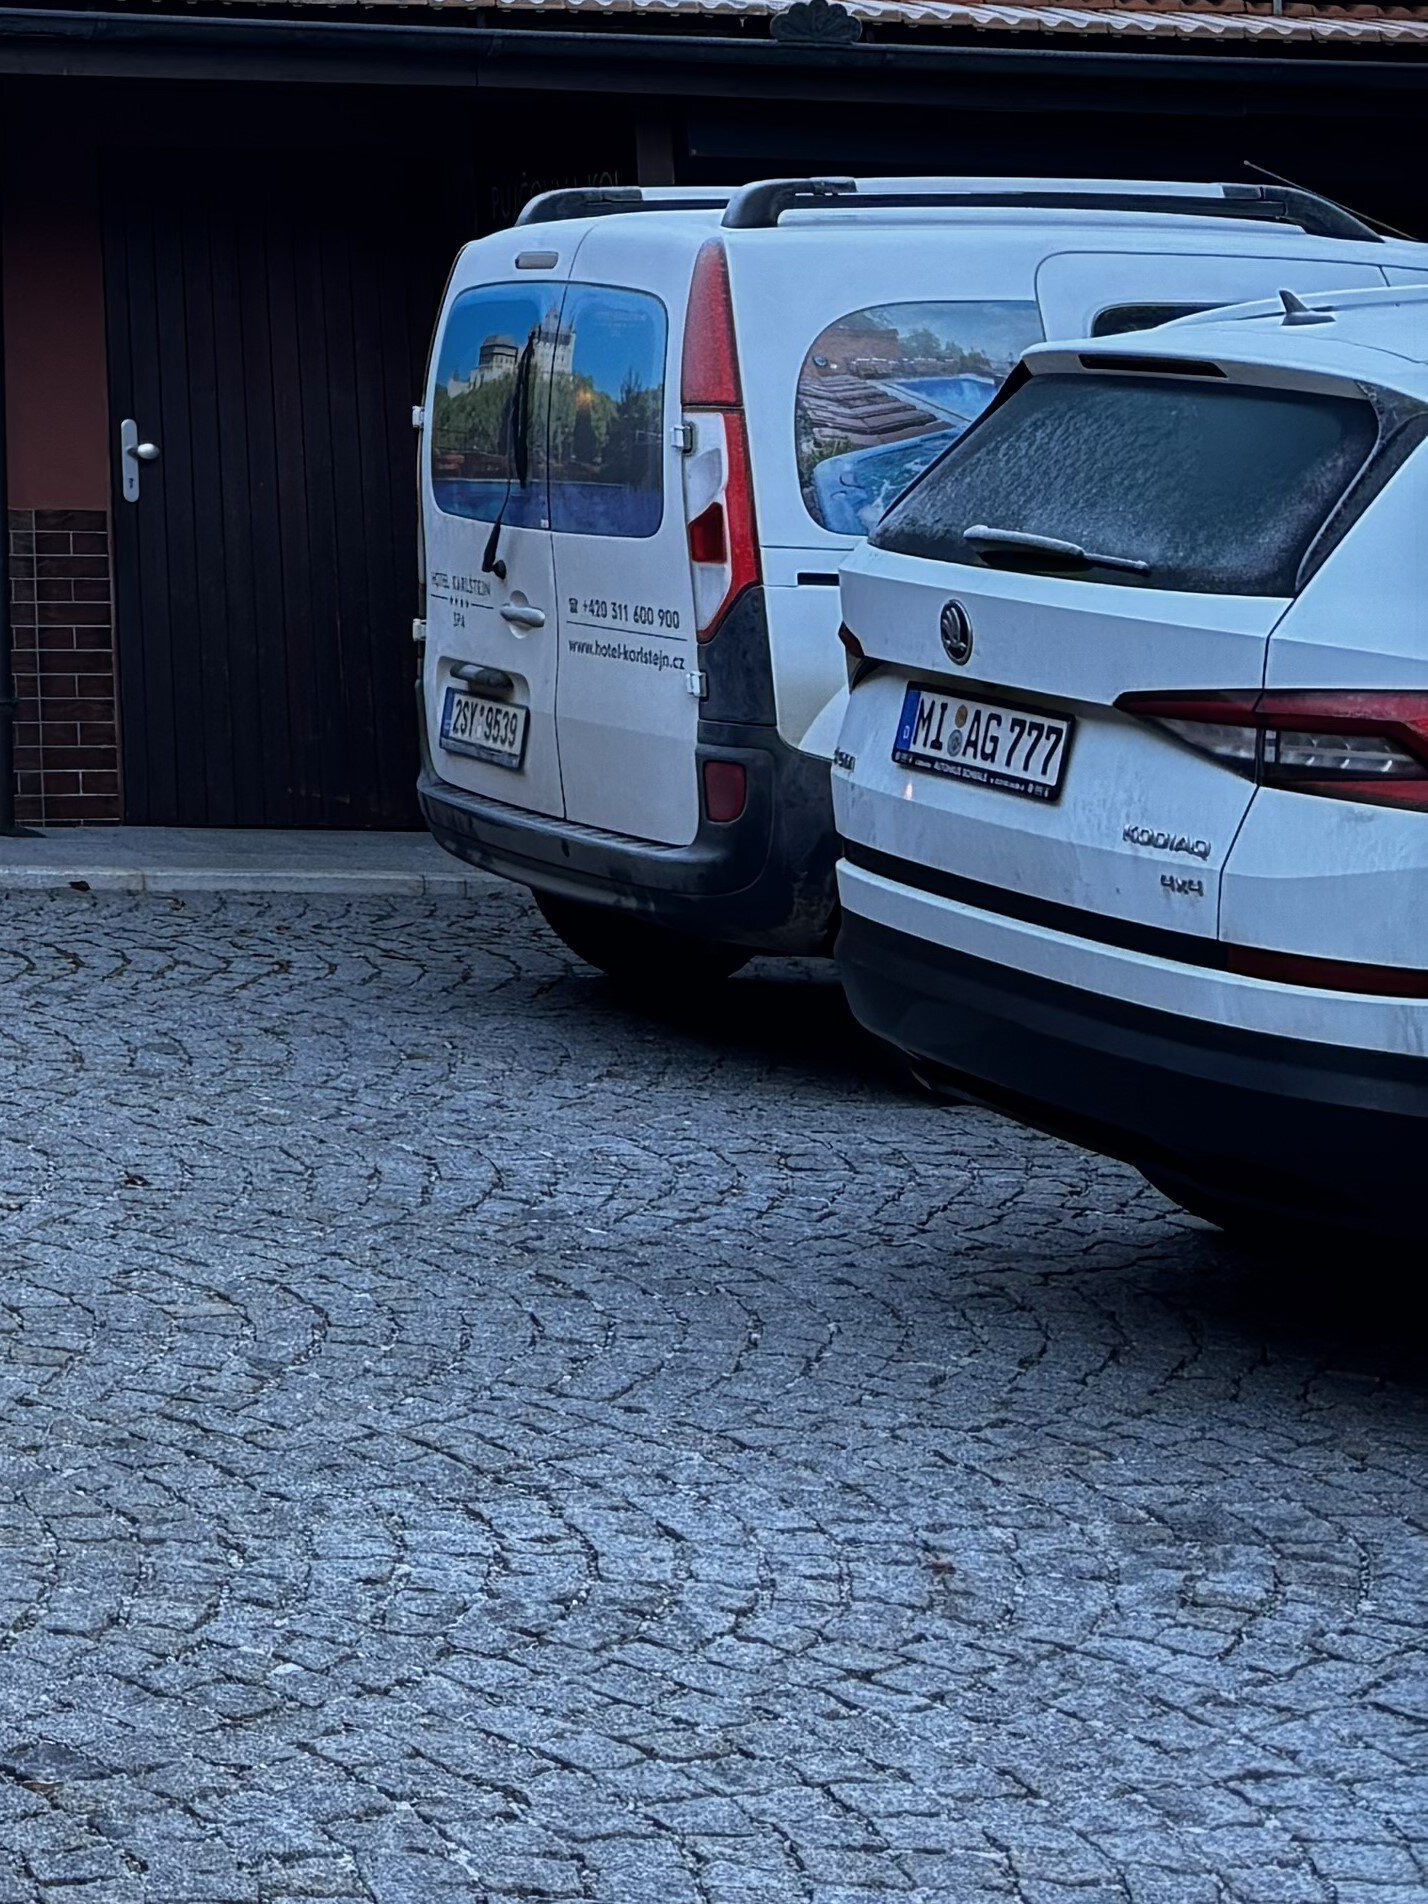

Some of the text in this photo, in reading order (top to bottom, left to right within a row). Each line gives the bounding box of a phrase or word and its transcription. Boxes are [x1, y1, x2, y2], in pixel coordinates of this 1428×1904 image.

[582, 599, 680, 629] +420 311 600 900
[484, 706, 518, 748] 9539
[912, 698, 1065, 777] MI AG 777
[1123, 825, 1212, 862] KODIAQ
